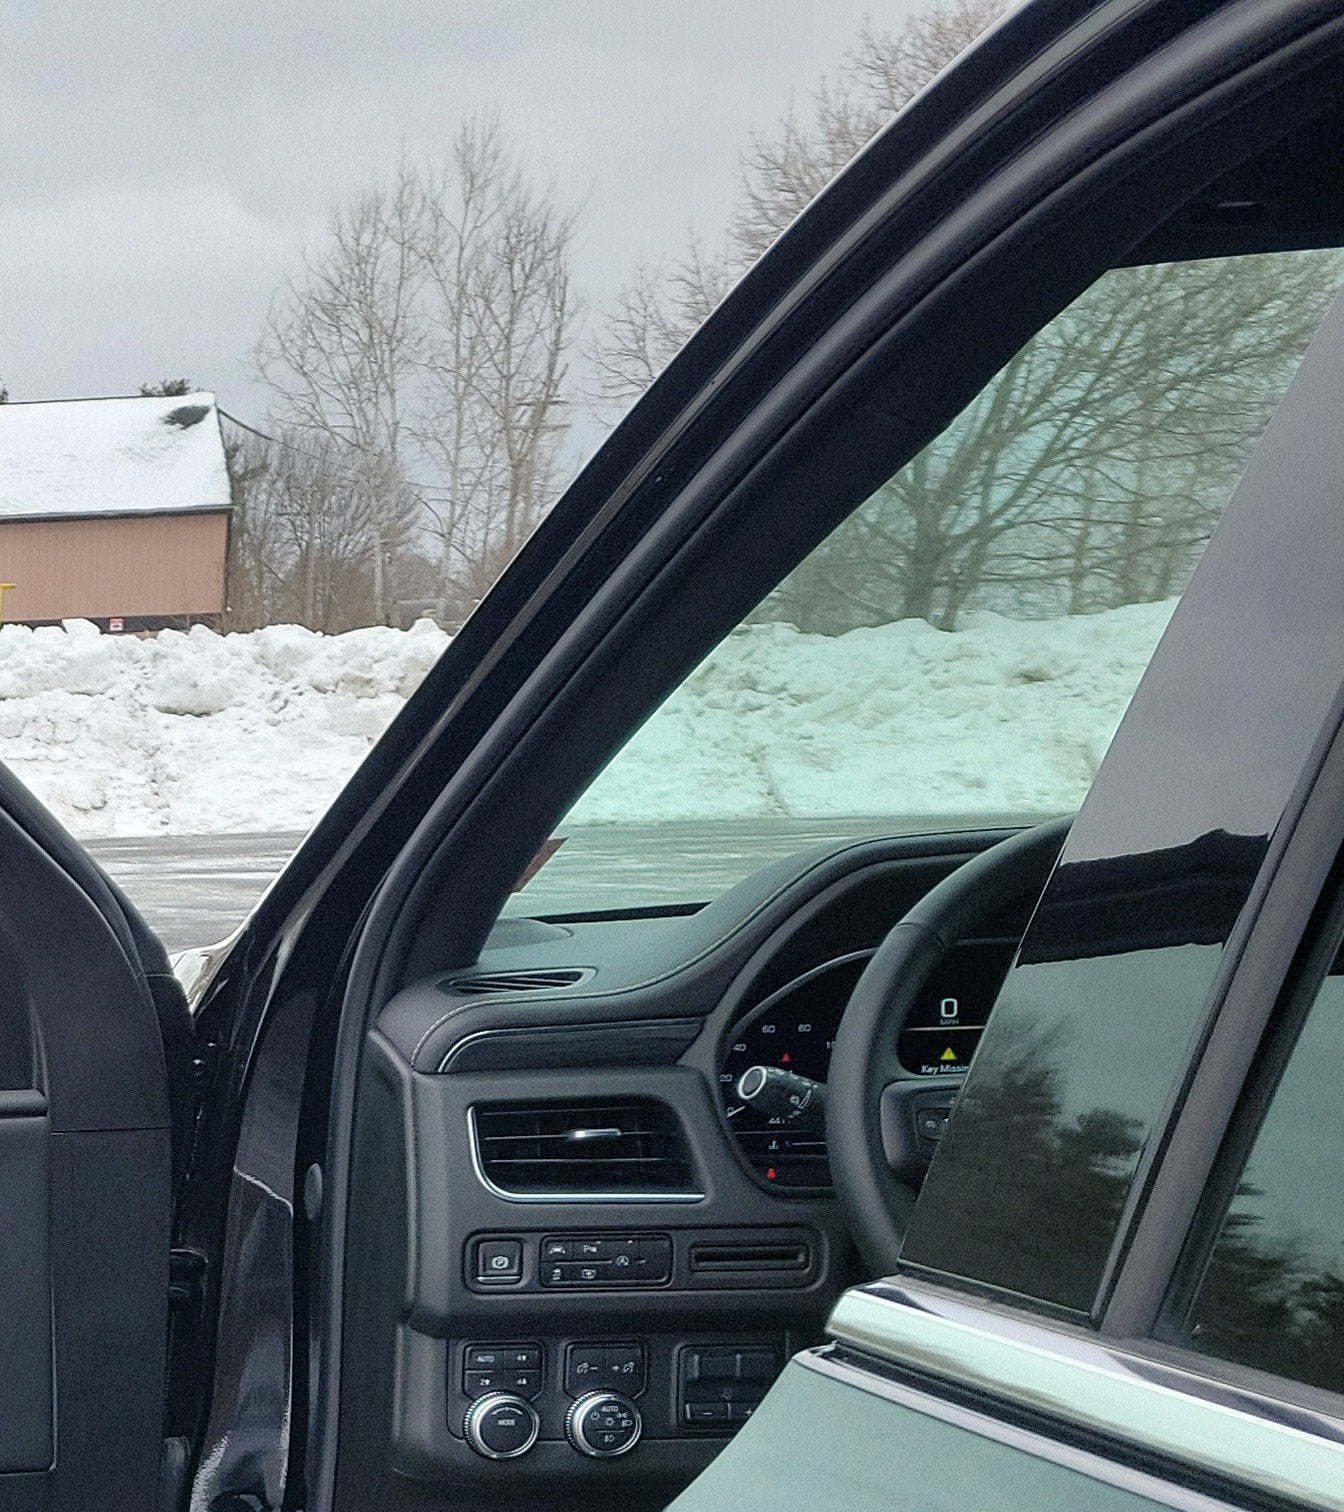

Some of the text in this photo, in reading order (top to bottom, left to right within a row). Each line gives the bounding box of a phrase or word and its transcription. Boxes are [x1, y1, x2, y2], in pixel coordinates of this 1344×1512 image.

[940, 998, 958, 1018] 0
[921, 1064, 970, 1075] Key Missin
[477, 1355, 495, 1363] AUTO
[601, 1404, 619, 1413] AUTO
